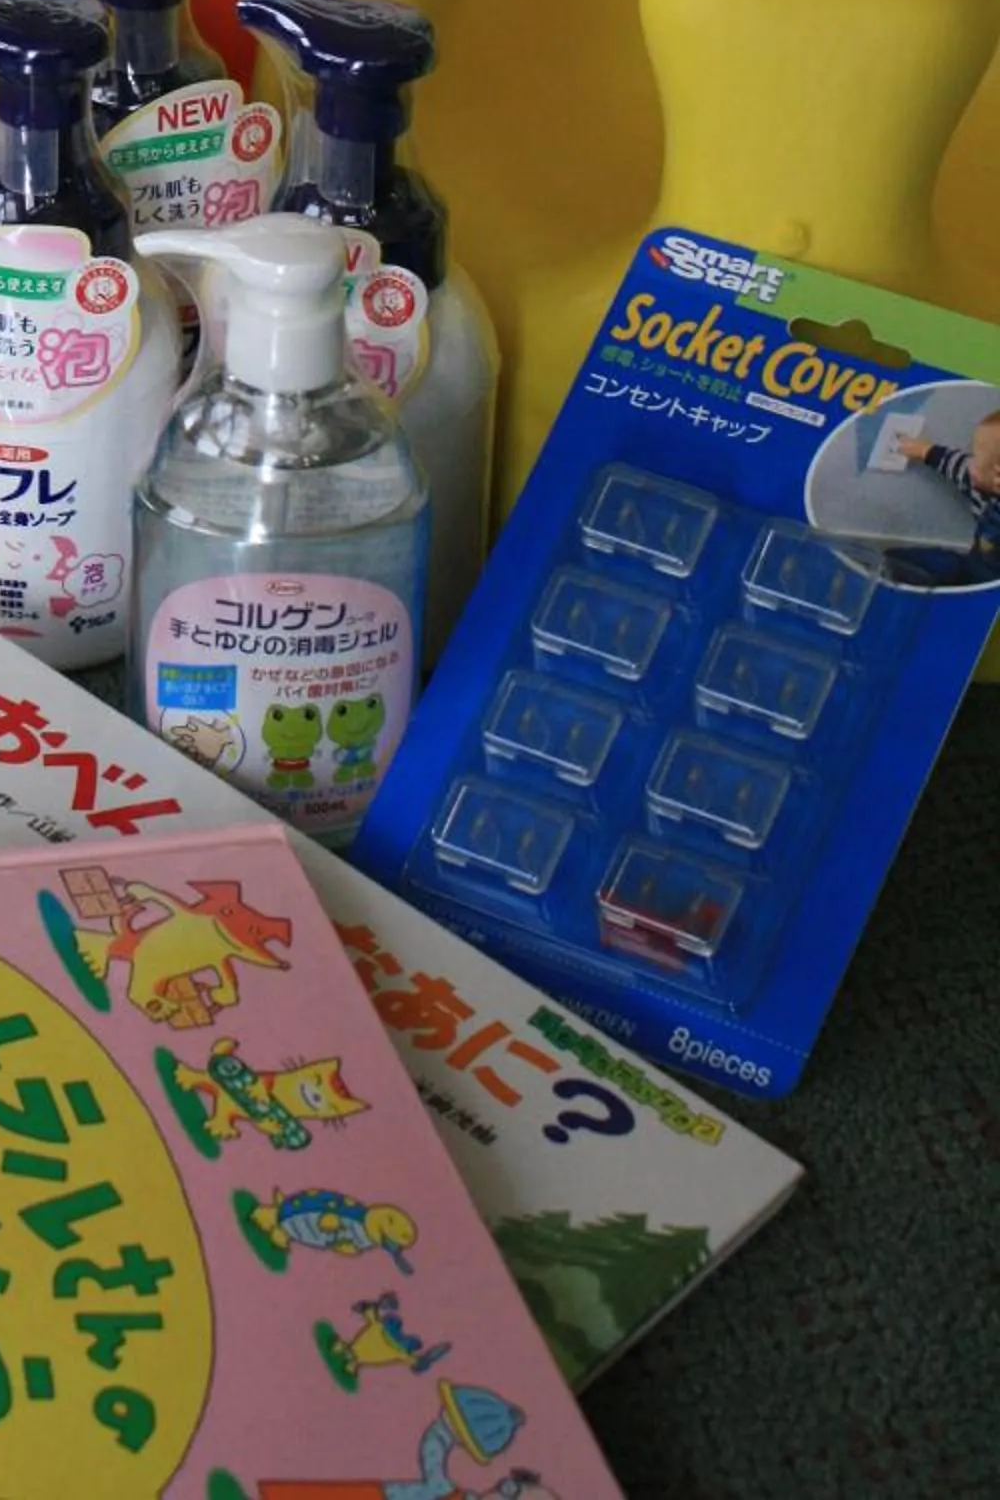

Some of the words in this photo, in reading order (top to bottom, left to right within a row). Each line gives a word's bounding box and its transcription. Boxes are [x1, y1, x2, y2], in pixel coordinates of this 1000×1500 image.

[157, 93, 229, 132] NEW
[660, 235, 783, 285] Smart
[669, 257, 782, 303] Start
[36, 327, 111, 390] 泡
[610, 293, 765, 379] Socket
[762, 341, 899, 416] Cover
[583, 372, 773, 443] コンセントキャップ
[169, 616, 399, 658] 手とゆびの消毒ジェル
[214, 598, 348, 631] コルゲン
[667, 1024, 773, 1090] 8pieces
